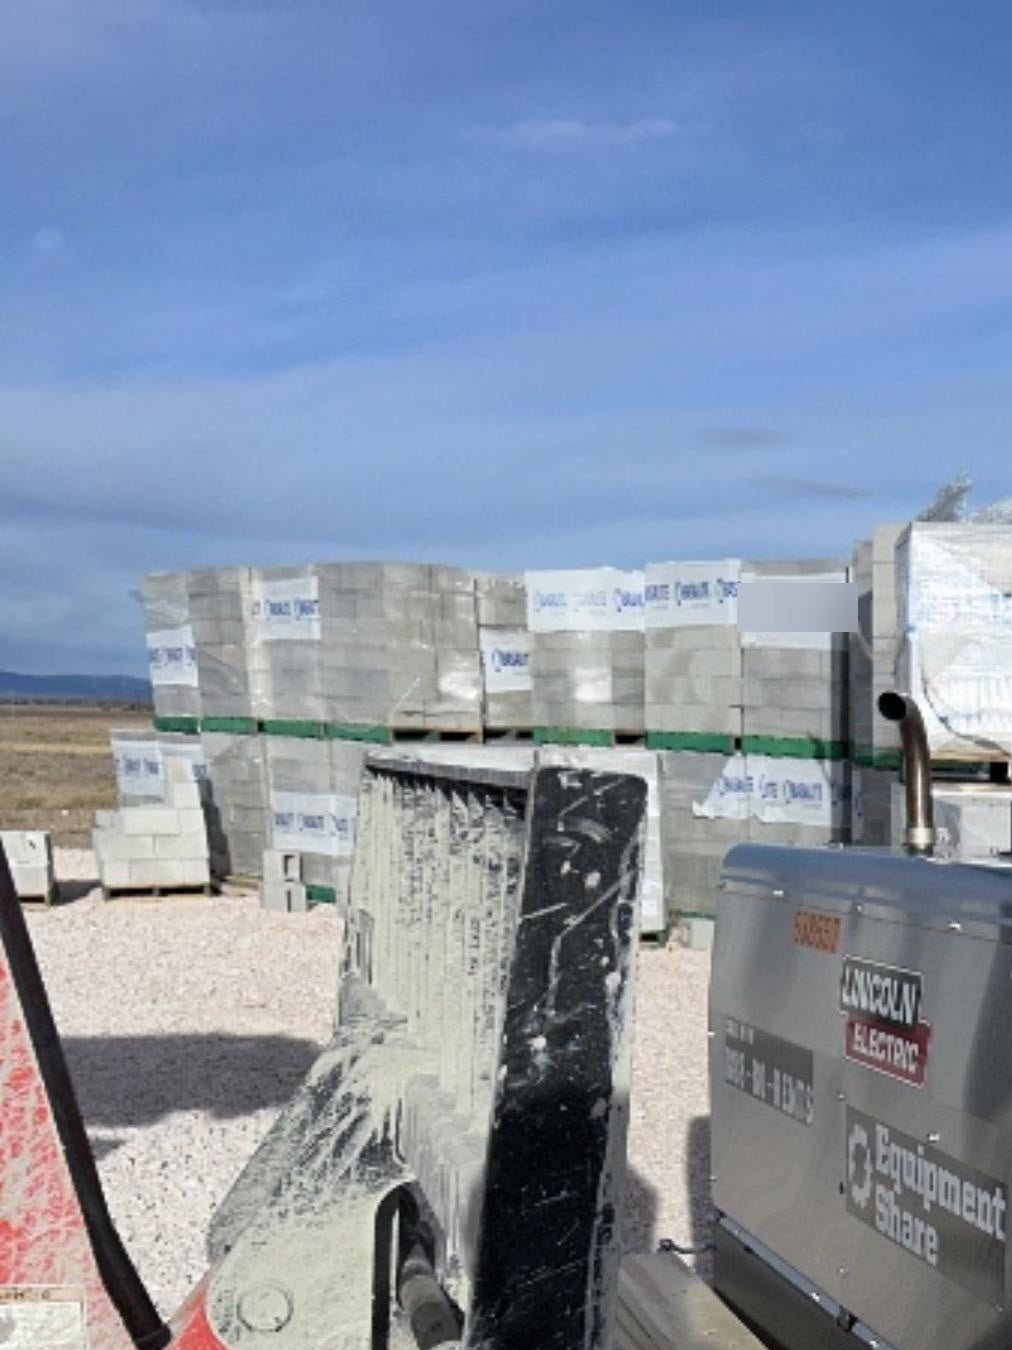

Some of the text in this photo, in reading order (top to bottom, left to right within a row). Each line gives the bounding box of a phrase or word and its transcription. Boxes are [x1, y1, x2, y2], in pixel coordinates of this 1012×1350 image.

[841, 966, 917, 1026] LINCOLN
[853, 1023, 920, 1075] ELECTRIC
[874, 1122, 1007, 1241] Equipment
[875, 1183, 939, 1266] Share
